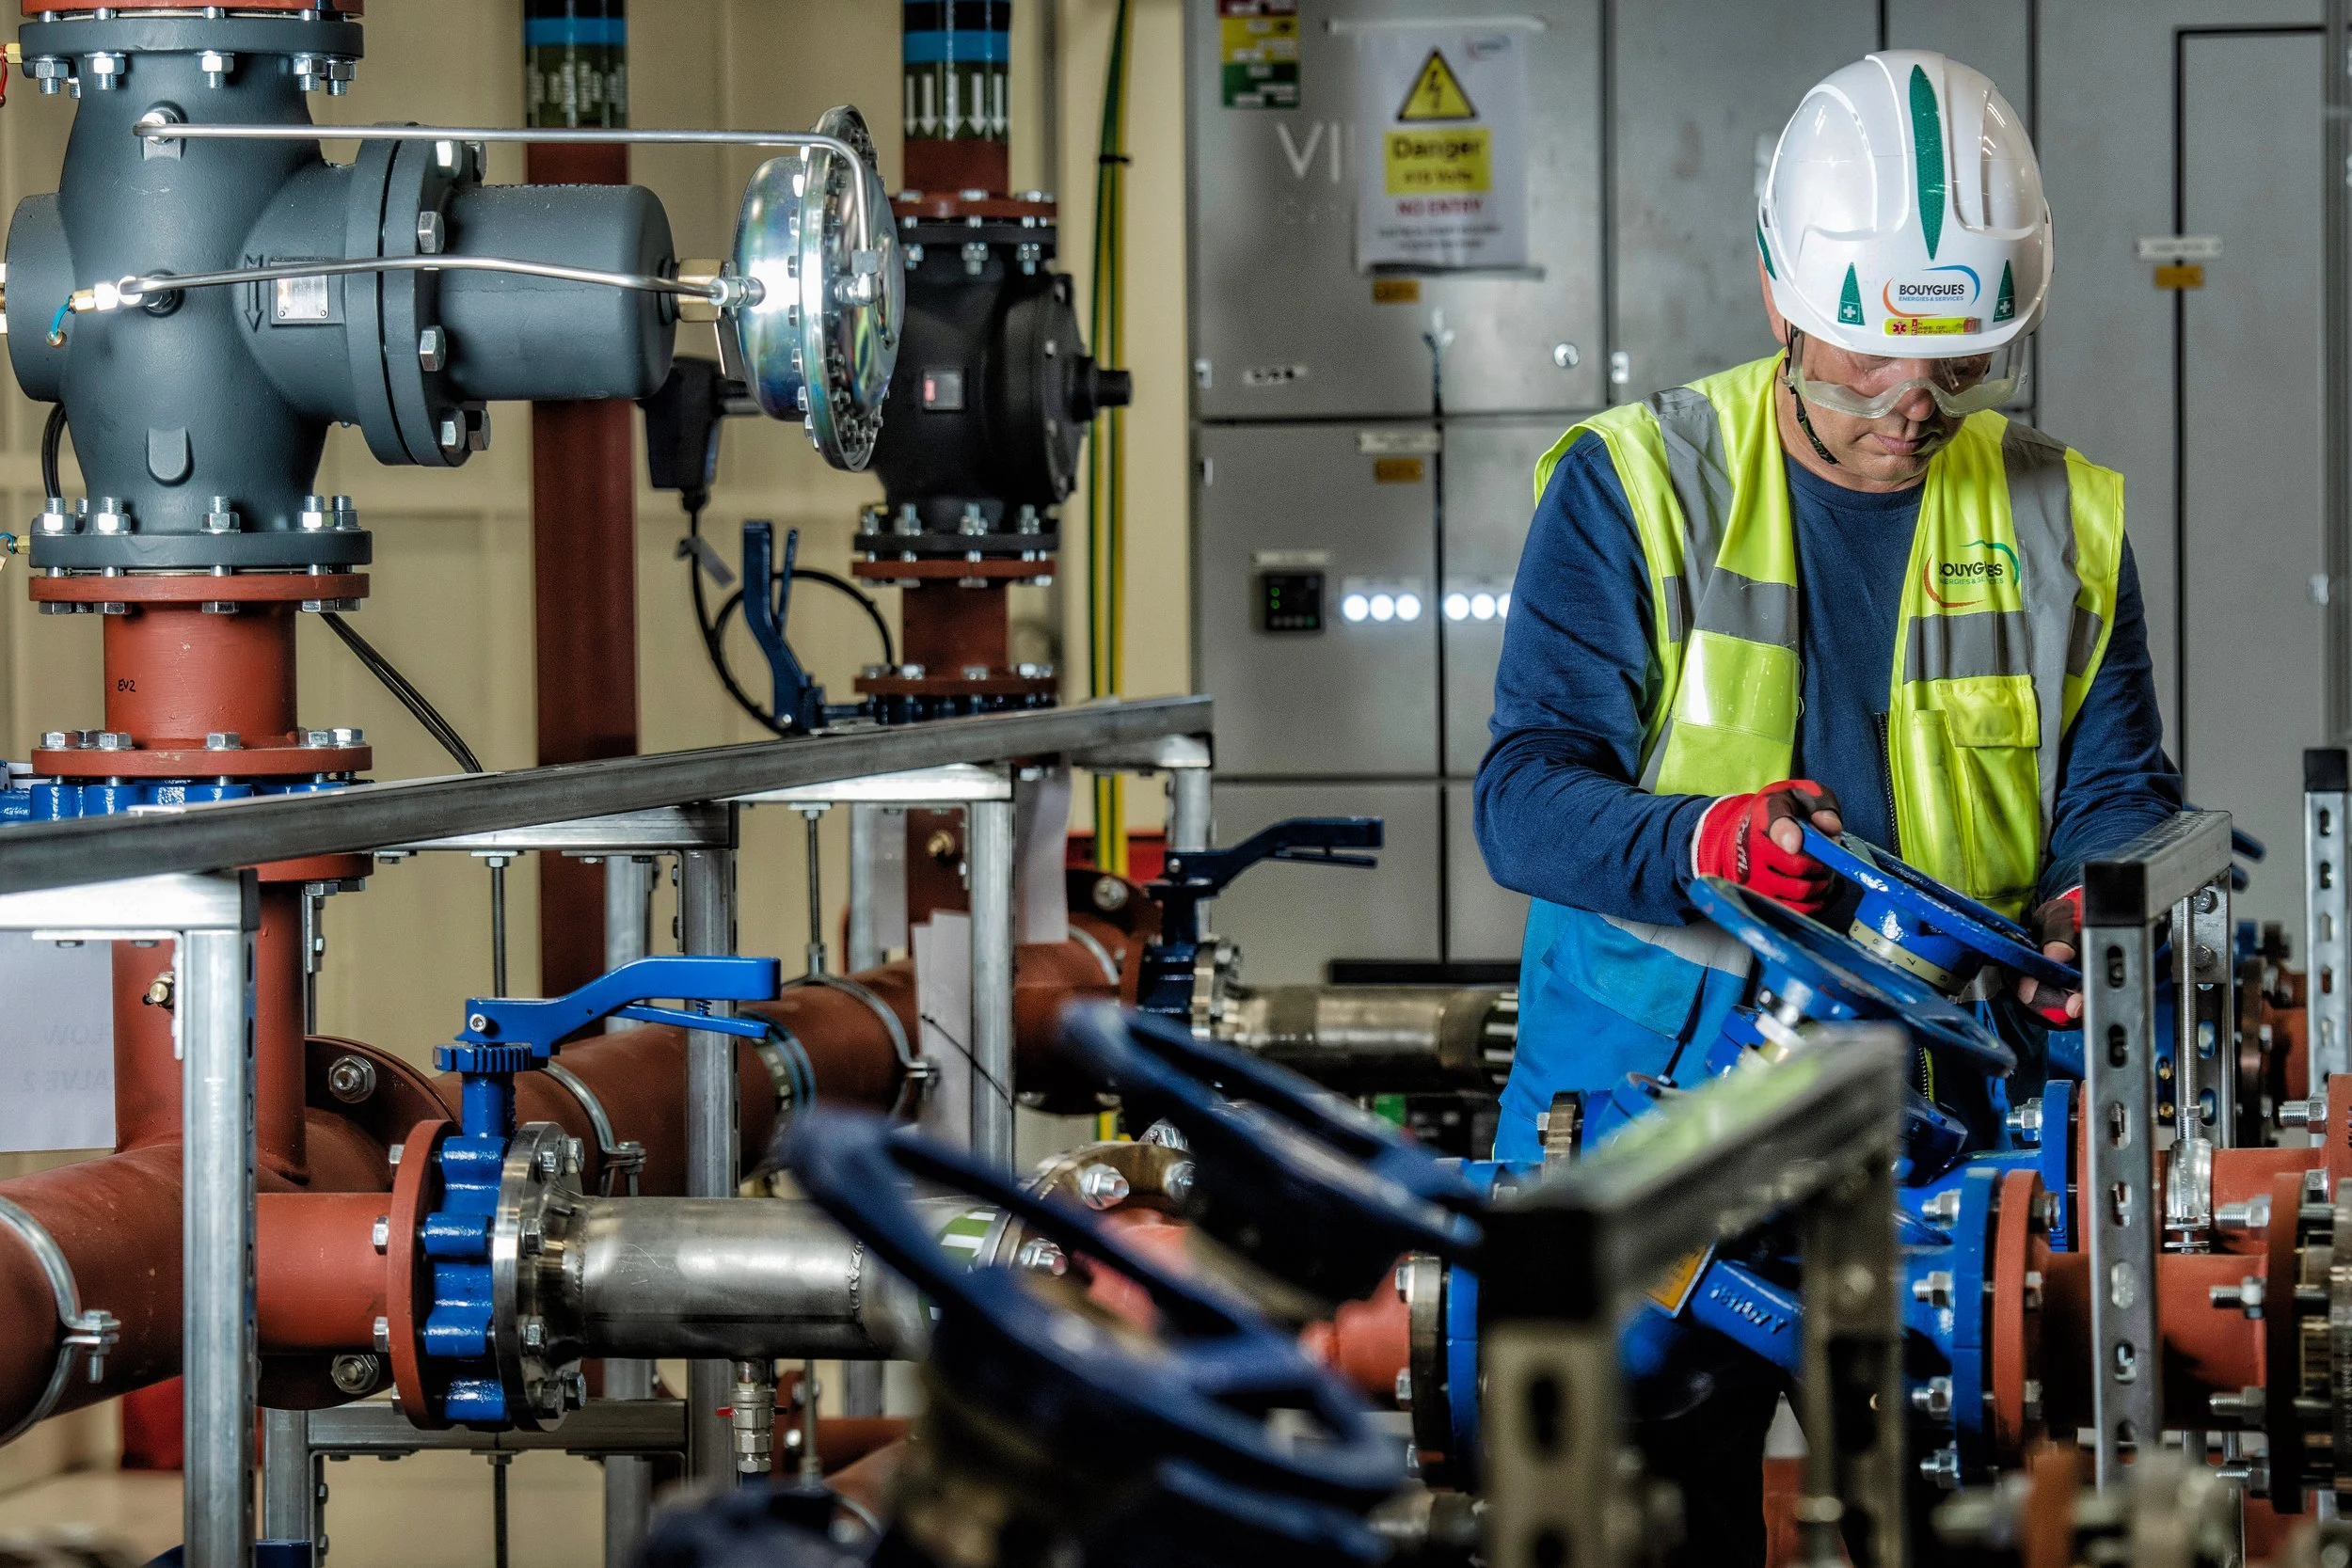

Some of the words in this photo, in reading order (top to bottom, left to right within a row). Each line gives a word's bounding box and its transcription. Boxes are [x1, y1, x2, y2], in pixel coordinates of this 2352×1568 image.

[1393, 136, 1482, 162] Danger
[1899, 284, 1964, 295] BOUYGUES
[1906, 957, 1916, 966] 7
